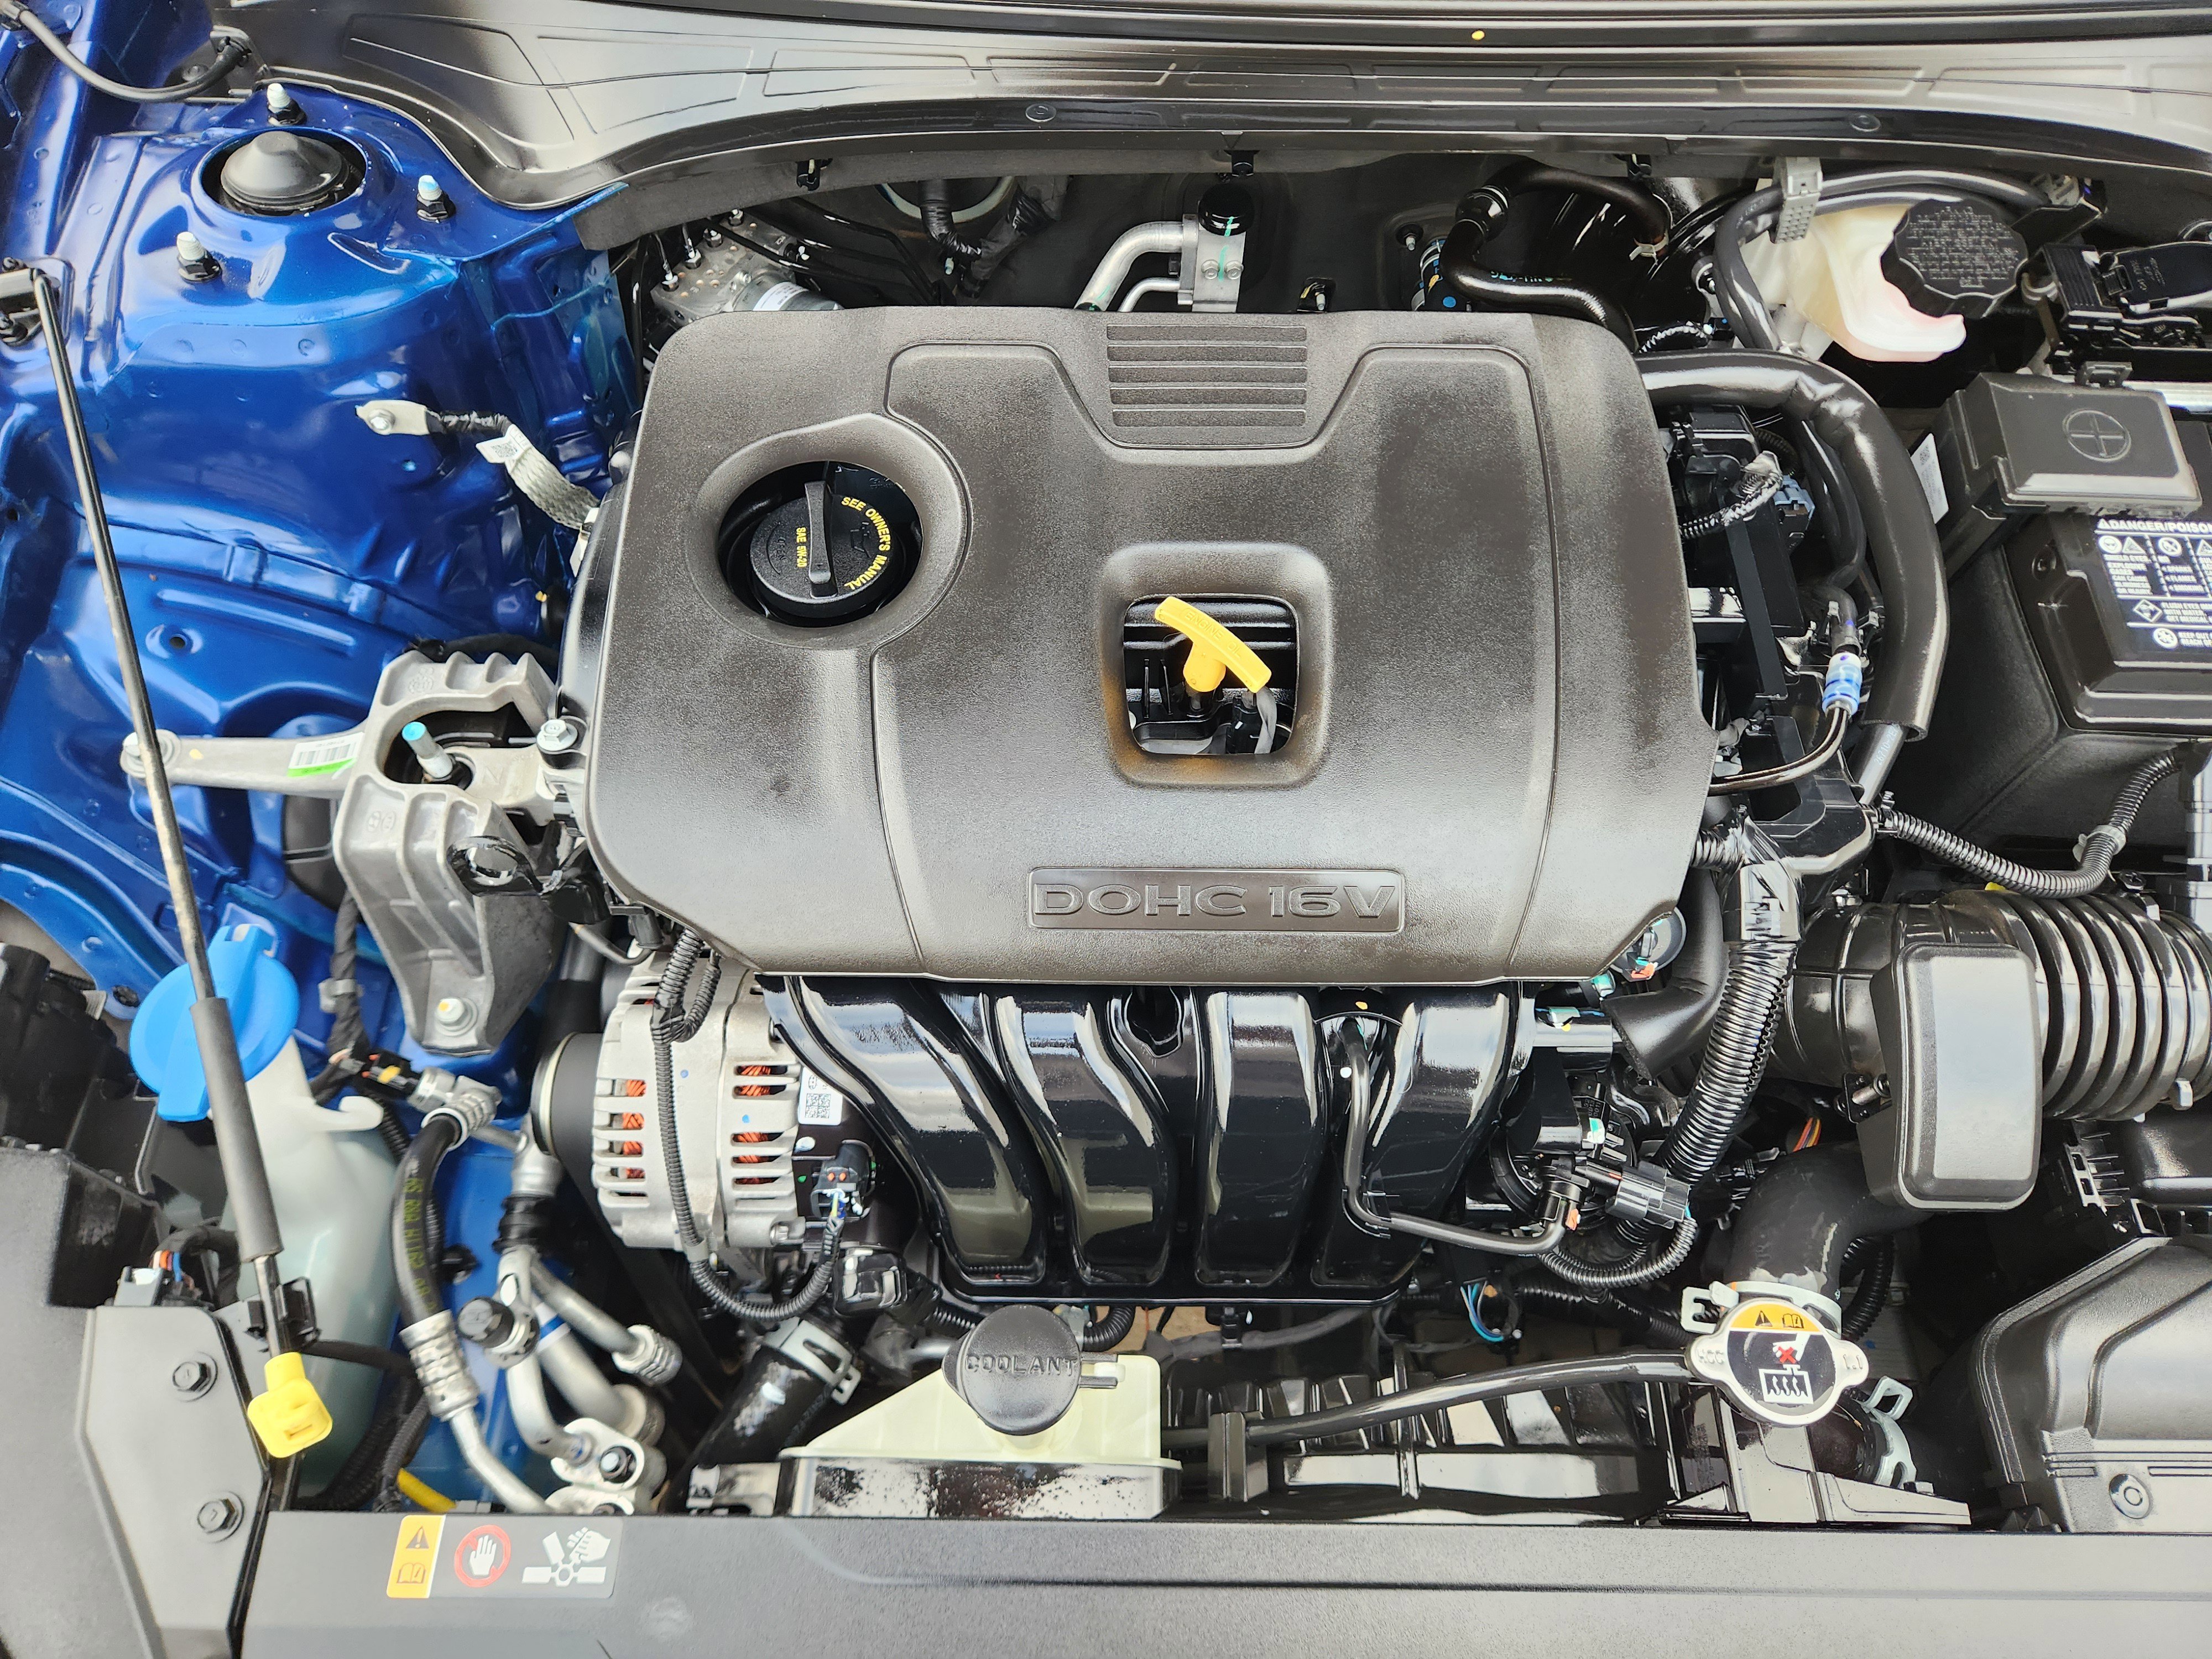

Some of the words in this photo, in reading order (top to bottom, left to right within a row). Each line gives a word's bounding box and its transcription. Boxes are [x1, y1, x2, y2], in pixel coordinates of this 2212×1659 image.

[841, 497, 866, 511] SEE
[796, 527, 807, 543] SAE
[865, 508, 891, 551] OWNER'S
[797, 545, 807, 567] 5W-20
[844, 554, 887, 590] MANUAL
[1185, 611, 1224, 641] ENGINE
[1227, 641, 1241, 659] OIL
[1034, 884, 1248, 916] DOHC
[1269, 885, 1396, 919] 16V
[965, 1355, 1078, 1376] COOLANT
